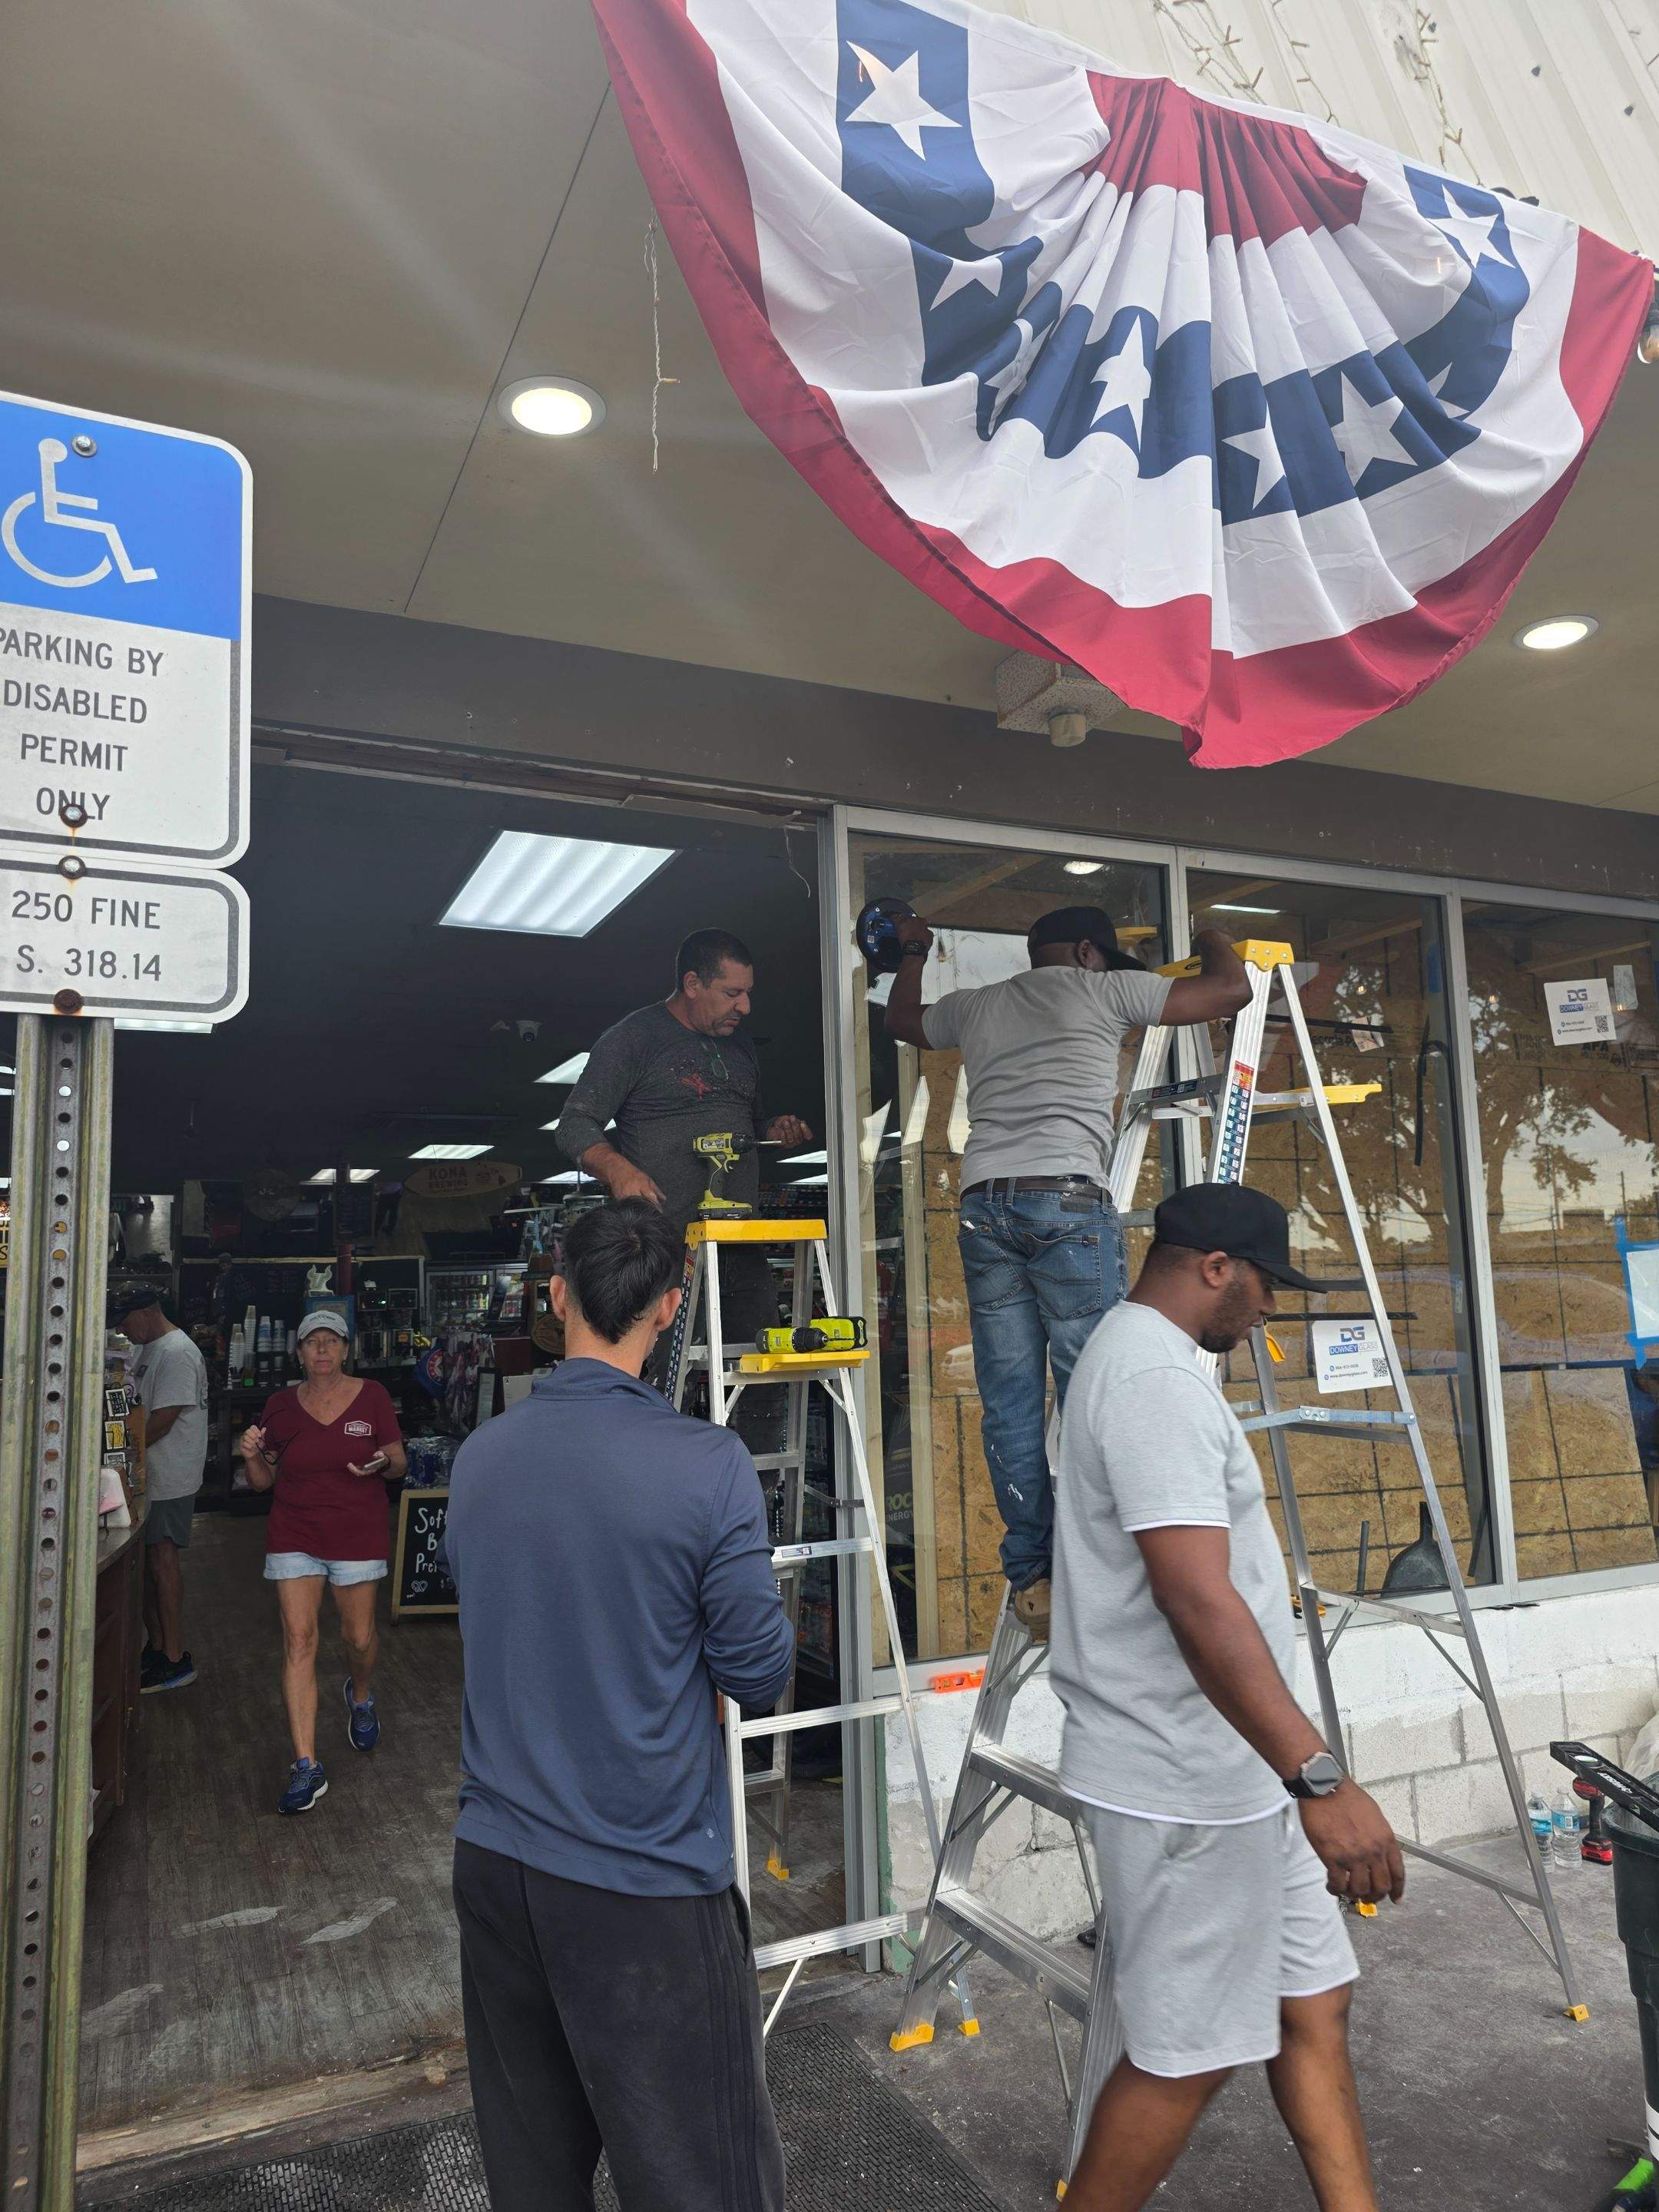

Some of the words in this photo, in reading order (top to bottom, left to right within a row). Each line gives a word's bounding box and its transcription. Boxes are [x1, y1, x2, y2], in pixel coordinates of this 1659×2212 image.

[128, 647, 164, 677] BY
[4, 680, 147, 724] DISABLED
[21, 733, 128, 772] PERMIT
[12, 890, 73, 922] 250
[91, 897, 161, 929] FINE
[16, 945, 43, 973] S.
[64, 948, 161, 982] 318.14
[1567, 988, 1588, 1002] DG
[429, 1166, 467, 1180] KONA
[429, 1178, 468, 1190] BREWING
[1339, 1326, 1366, 1343] DG
[1330, 1344, 1358, 1355] DOWNEY
[1359, 1342, 1379, 1351] GLASS
